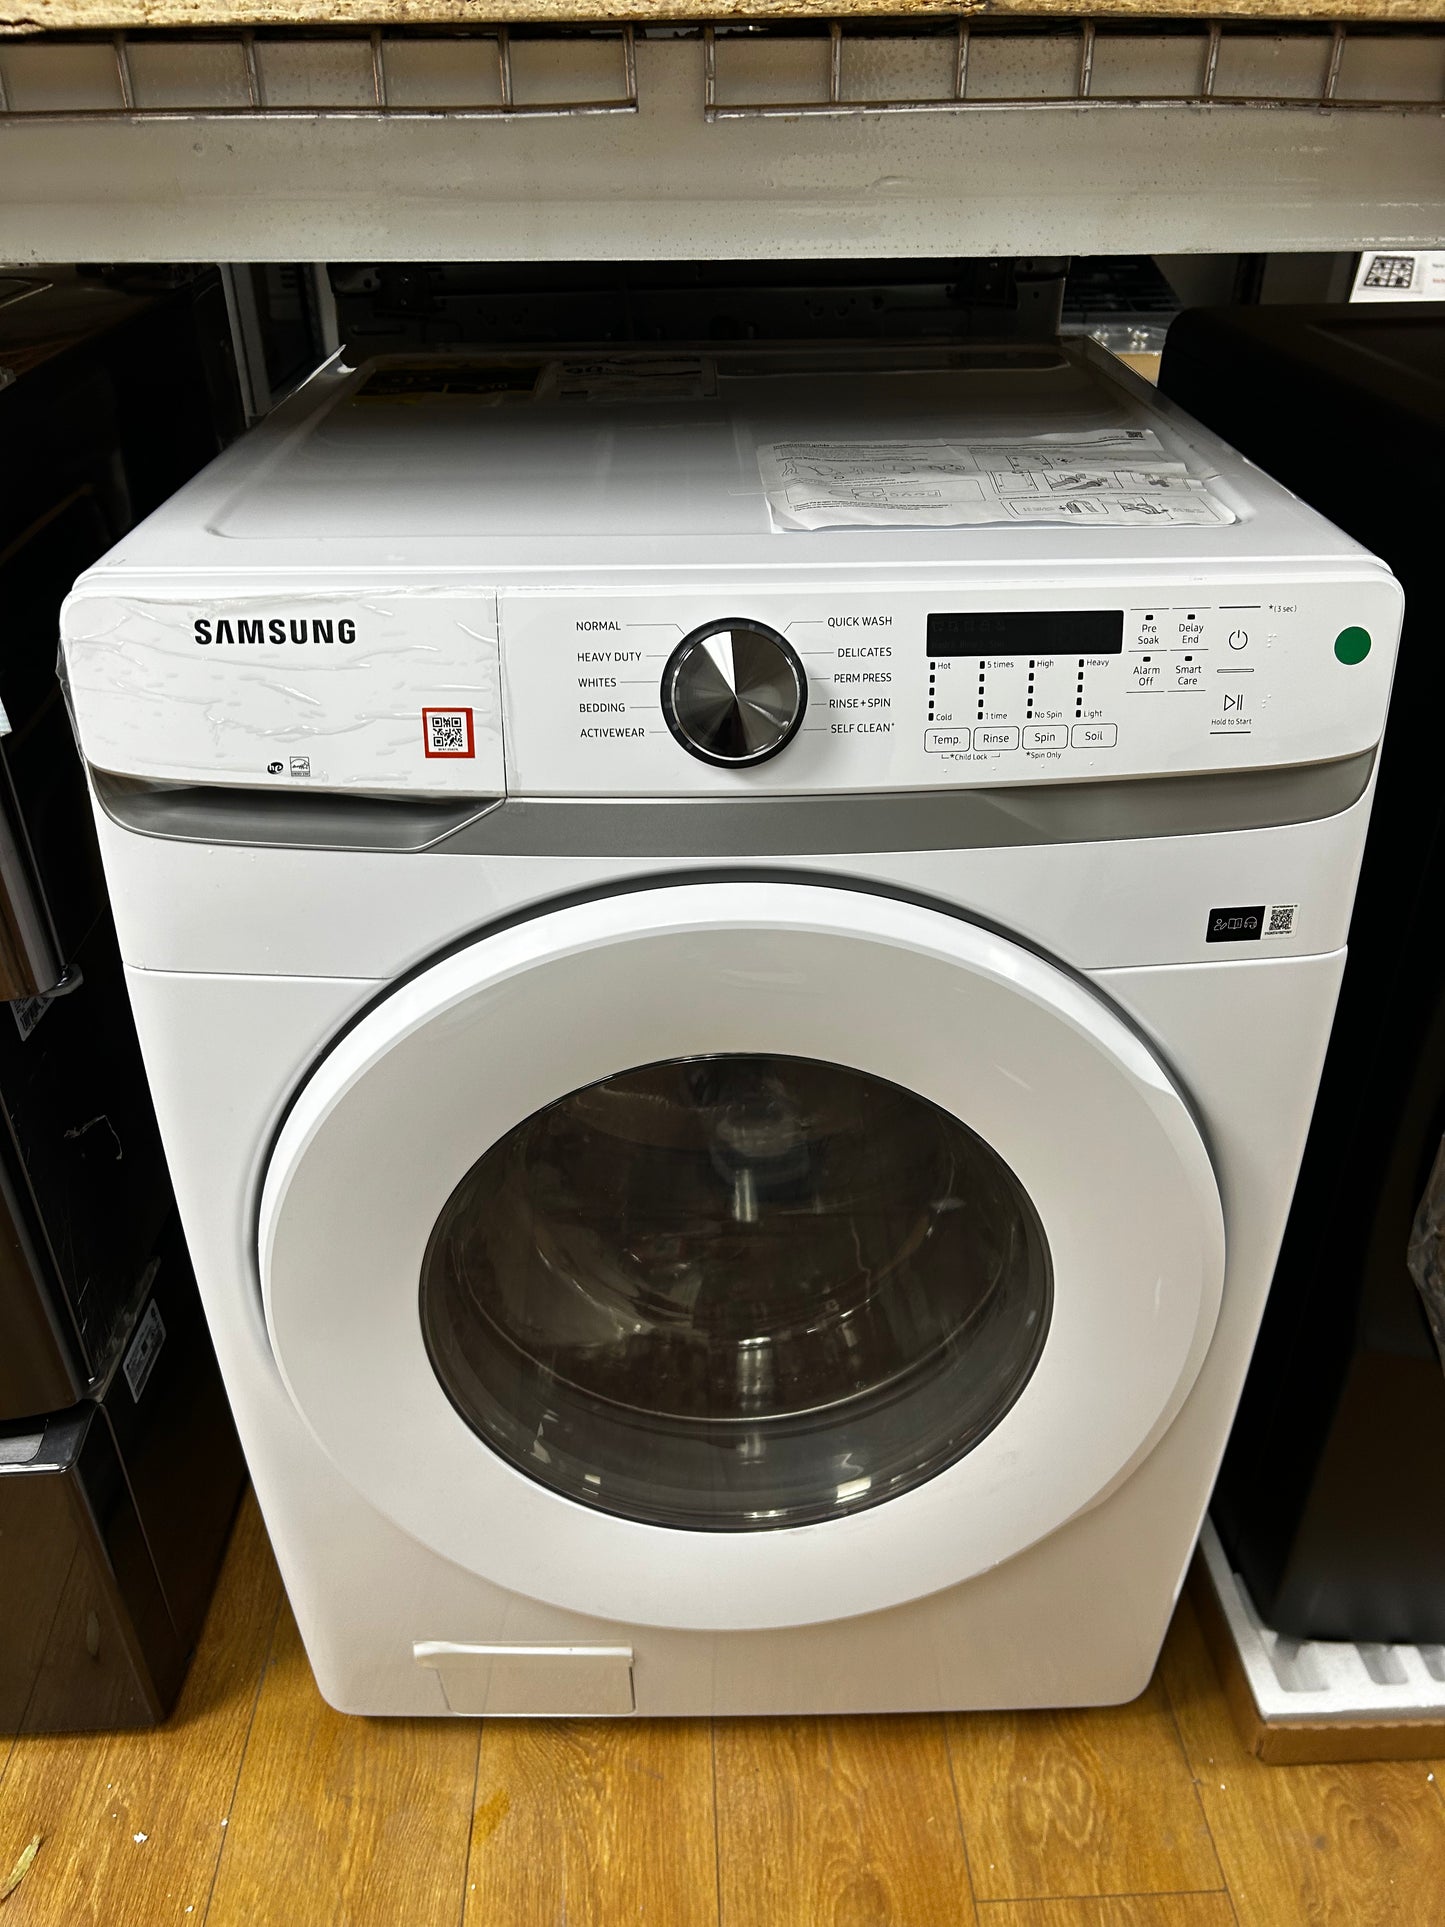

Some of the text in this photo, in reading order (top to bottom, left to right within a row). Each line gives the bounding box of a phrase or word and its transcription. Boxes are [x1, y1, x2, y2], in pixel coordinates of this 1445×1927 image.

[1282, 604, 1298, 613] sec)
[576, 620, 622, 632] NORMAL
[828, 616, 892, 628] QUICK WASH
[194, 619, 355, 645] SAMSUNG
[1141, 623, 1157, 633] Pre
[1178, 624, 1204, 634] Delay
[1137, 635, 1160, 645] Soak
[1181, 634, 1199, 644] End
[577, 651, 642, 663] HEAVY DUTY
[838, 646, 892, 658] DELICATES
[987, 660, 992, 669] 5
[1036, 659, 1055, 670] High
[1086, 658, 1110, 668] Heavy
[1132, 665, 1161, 675] Alarm
[1175, 664, 1202, 675] Smart
[577, 677, 617, 688] WHITES
[833, 672, 892, 684] PERM PRESS
[1138, 676, 1154, 687] Off
[1177, 676, 1198, 686] Care
[579, 702, 626, 713] BEDDING
[935, 713, 953, 722] Cold
[1046, 710, 1063, 720] Spin
[1083, 709, 1103, 719] Light
[580, 727, 645, 738] ACTIVEWEAR
[830, 723, 855, 734] SELF
[983, 733, 1010, 743] Rinse
[1034, 732, 1056, 744] Spin
[1084, 730, 1103, 741] Soil
[932, 736, 960, 746] Temp.
[1046, 751, 1062, 760] Only
